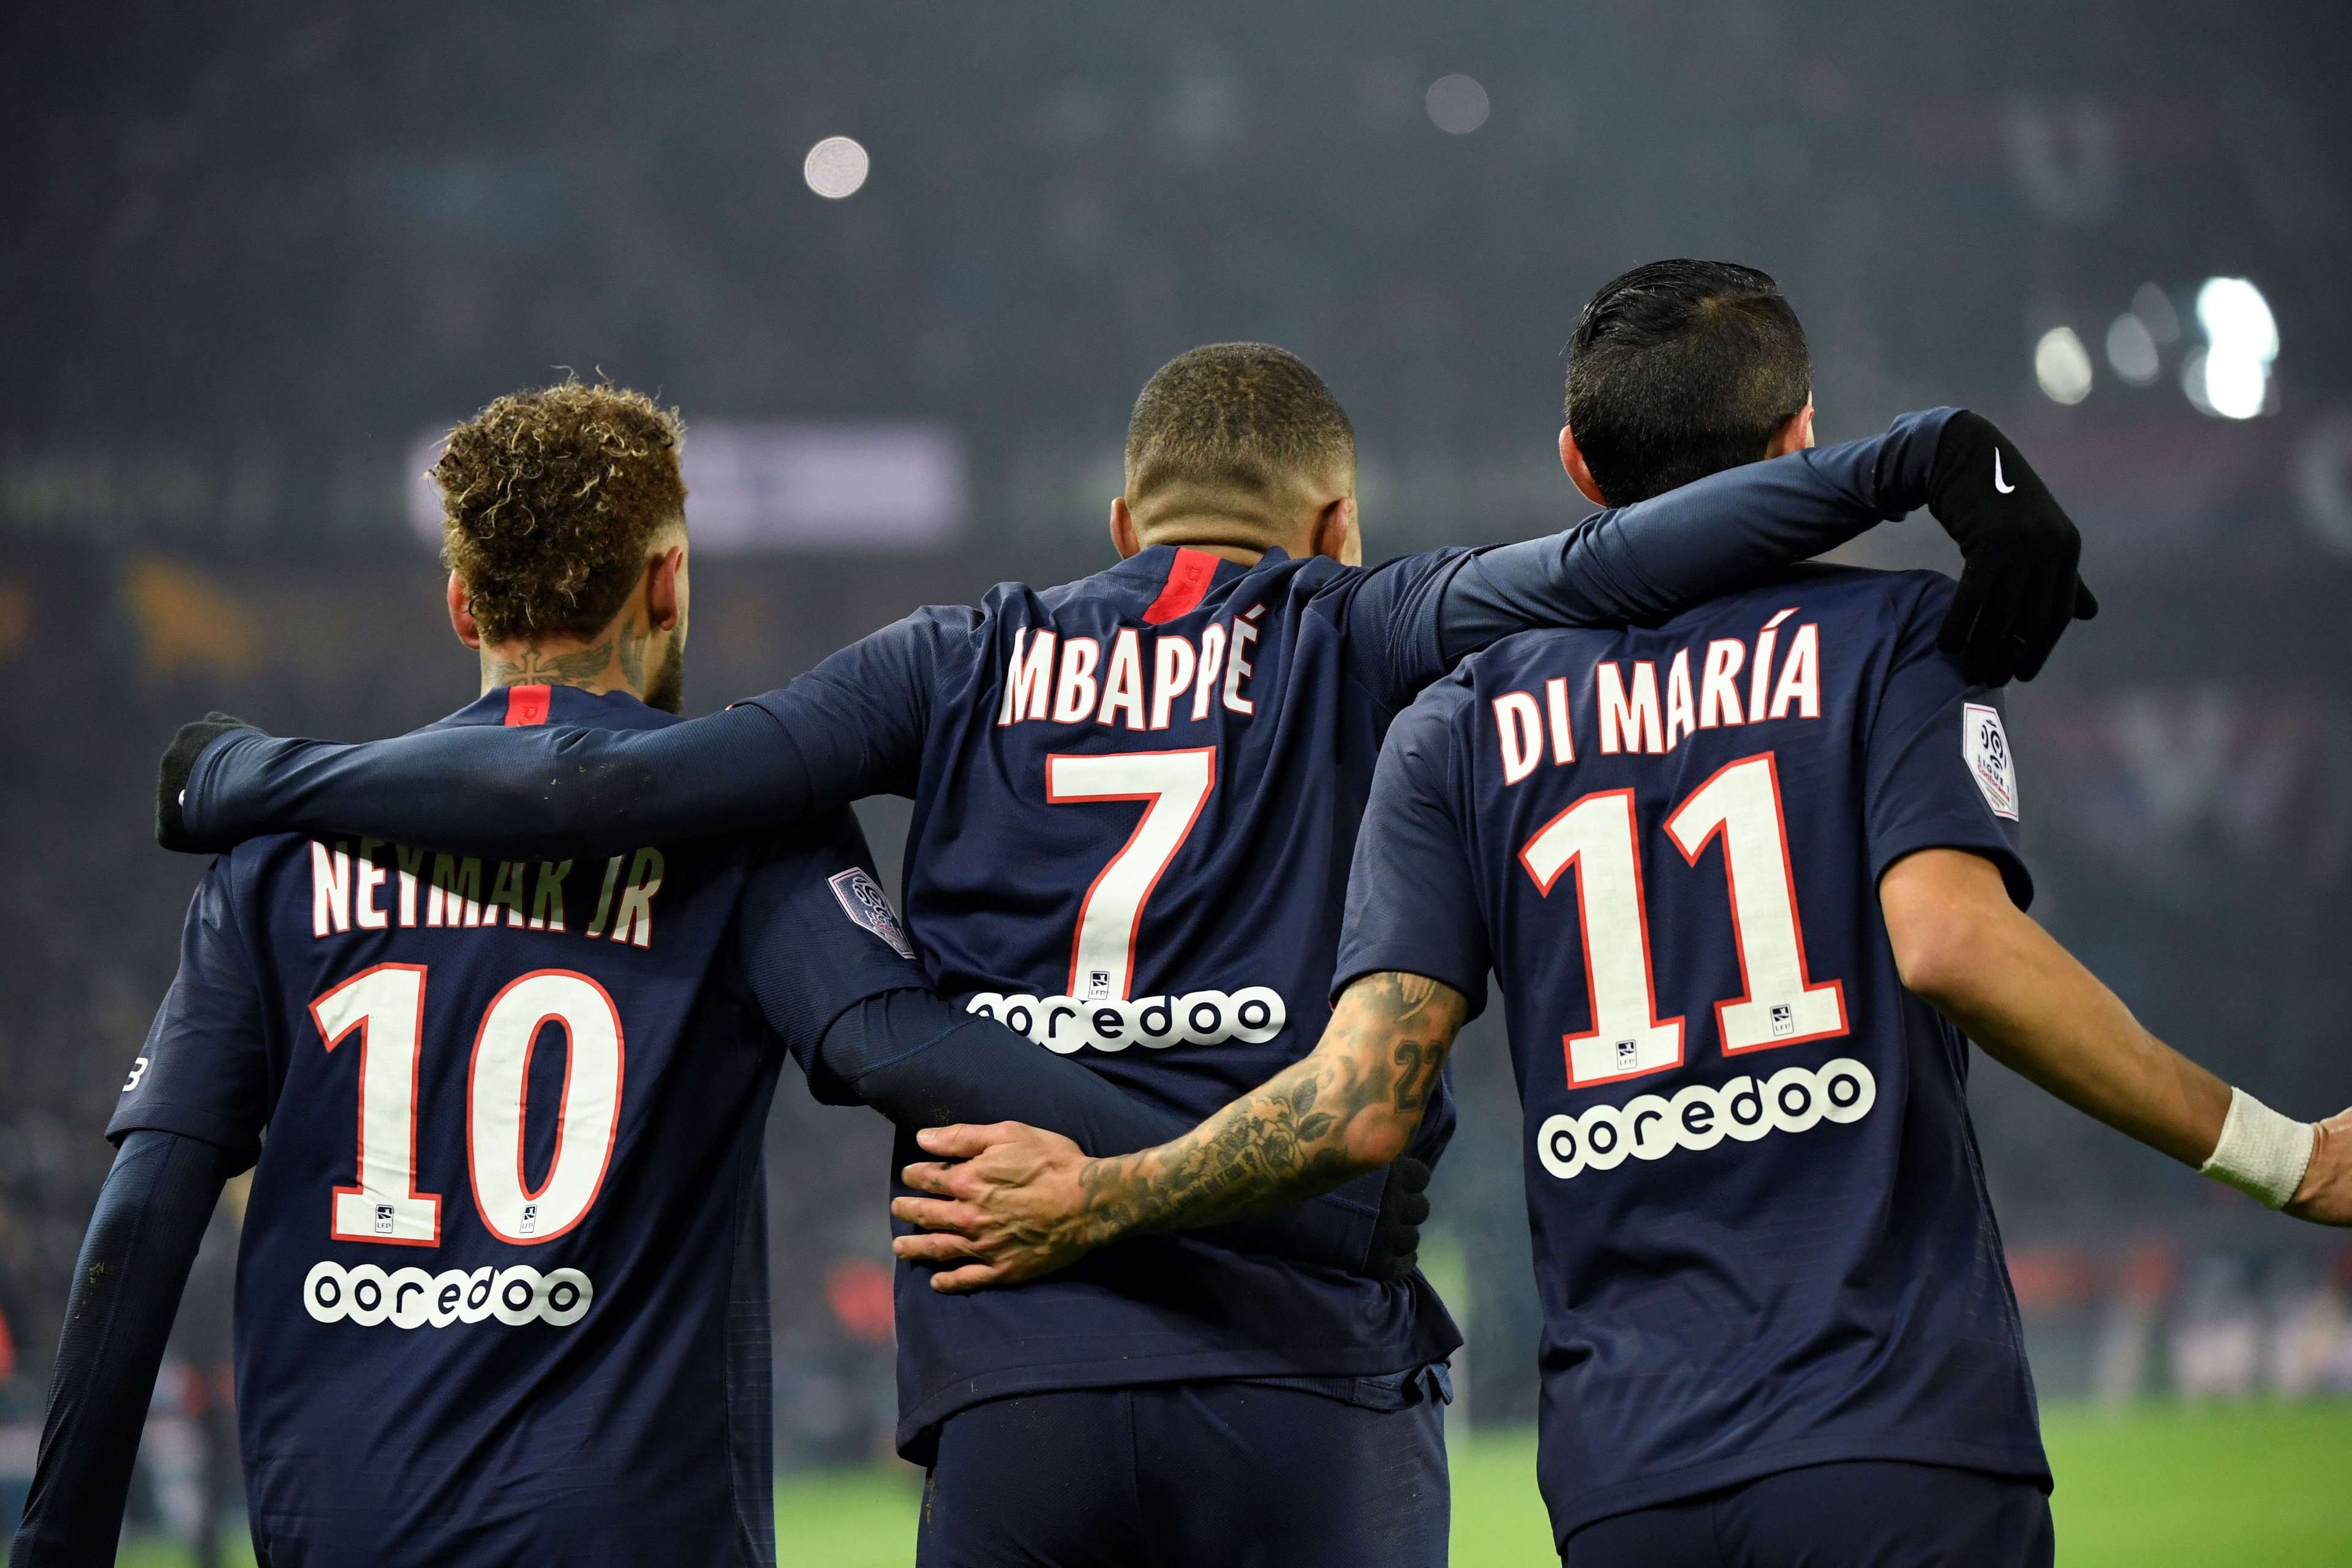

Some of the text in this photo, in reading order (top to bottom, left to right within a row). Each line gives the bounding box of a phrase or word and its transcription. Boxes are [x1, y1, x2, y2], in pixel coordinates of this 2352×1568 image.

[997, 601, 1267, 731] MBAPPÉ
[1492, 606, 1820, 786] DI MARÍA
[312, 839, 665, 949] NEYMAR JR
[1046, 745, 1217, 1001] 7
[1517, 751, 1849, 1090] 11
[308, 962, 625, 1247] 10
[1549, 1072, 1863, 1164] ooredoo
[313, 1265, 582, 1316] ooredoo
